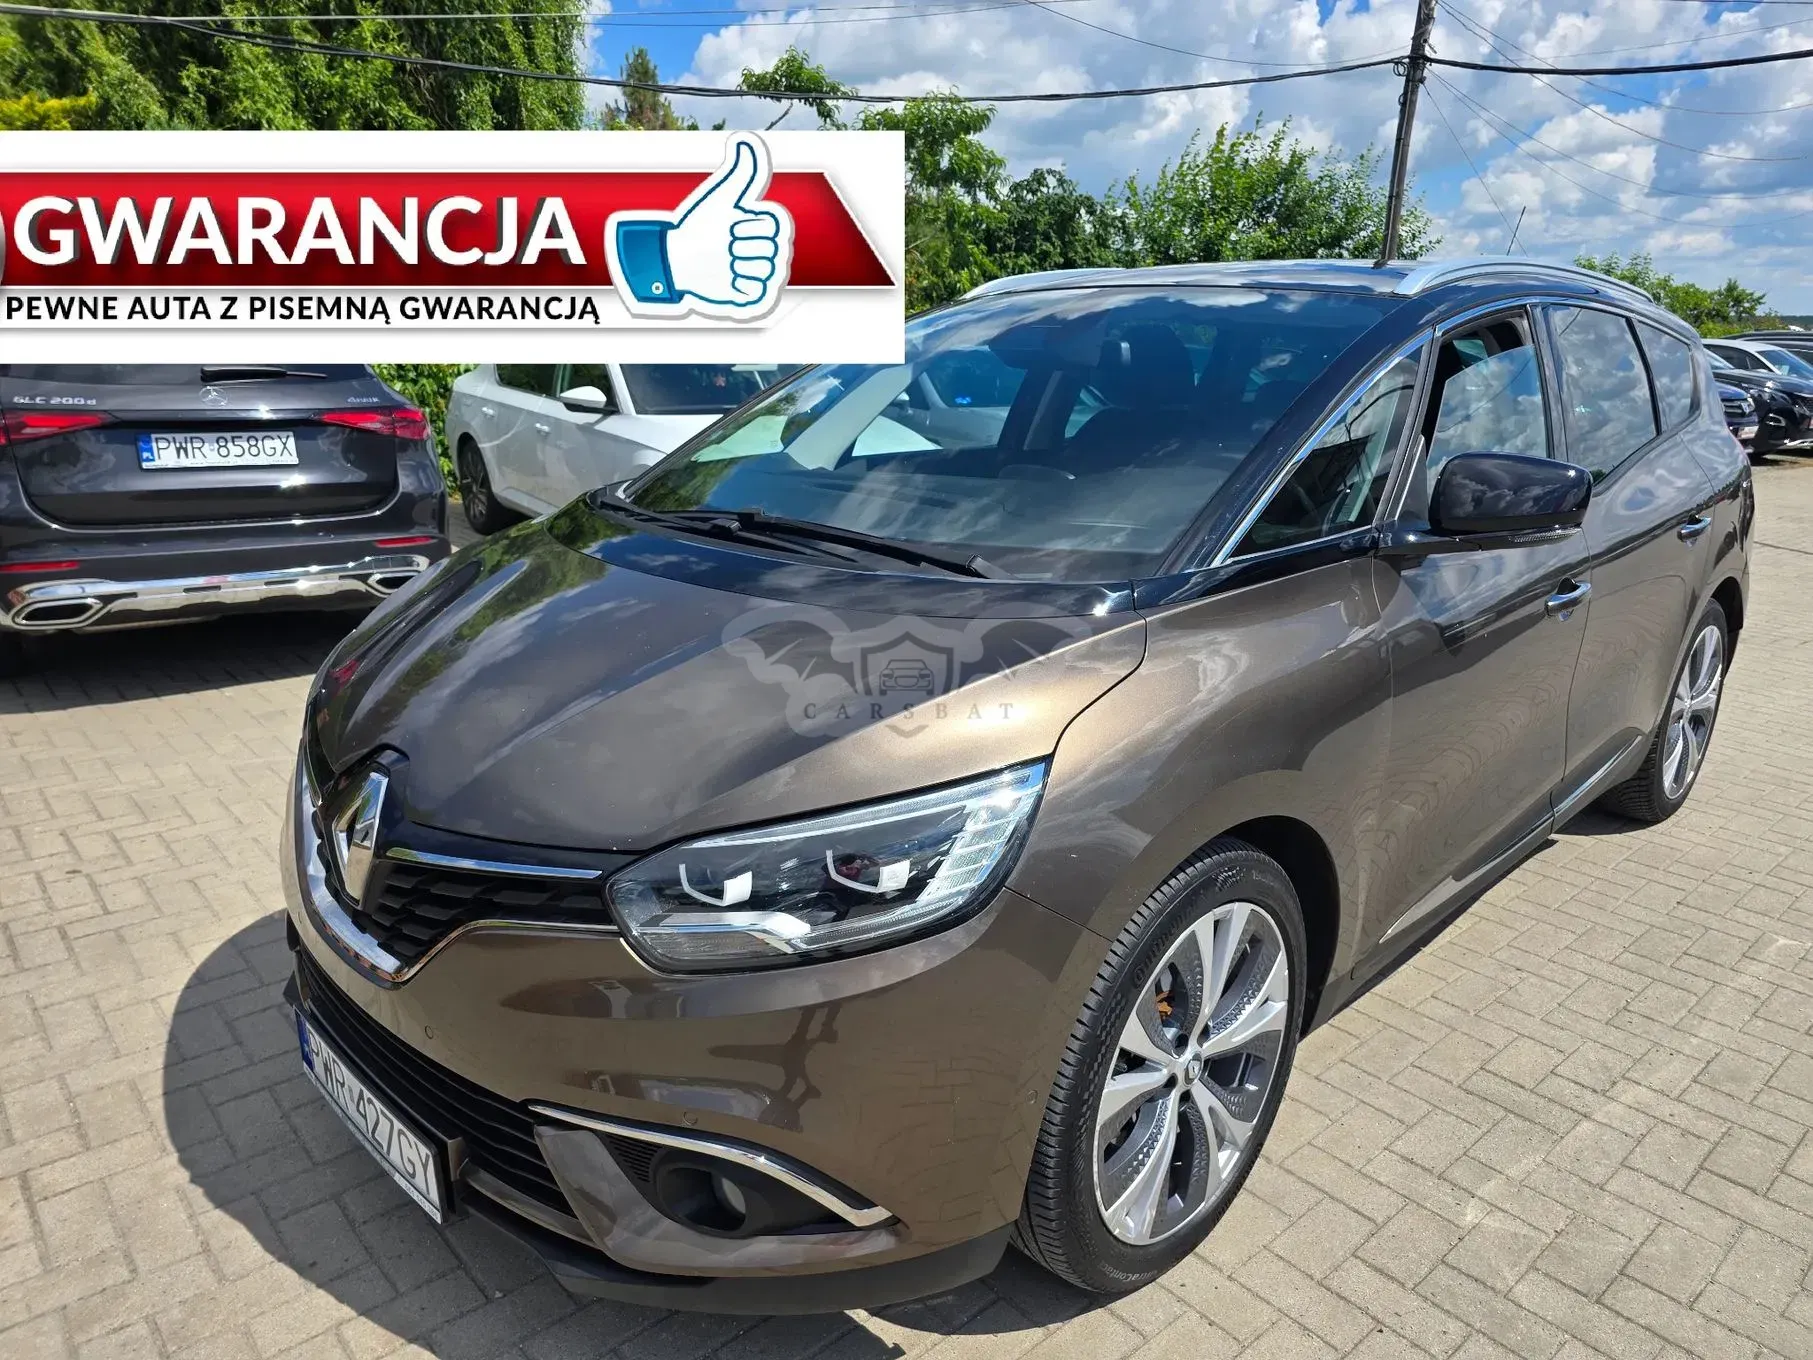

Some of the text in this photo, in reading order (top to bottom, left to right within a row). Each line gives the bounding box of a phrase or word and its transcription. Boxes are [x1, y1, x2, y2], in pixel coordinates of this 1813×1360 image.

[154, 434, 293, 460] PWR 858GX
[308, 1030, 350, 1113] PWR
[356, 1088, 431, 1196] 427GY
